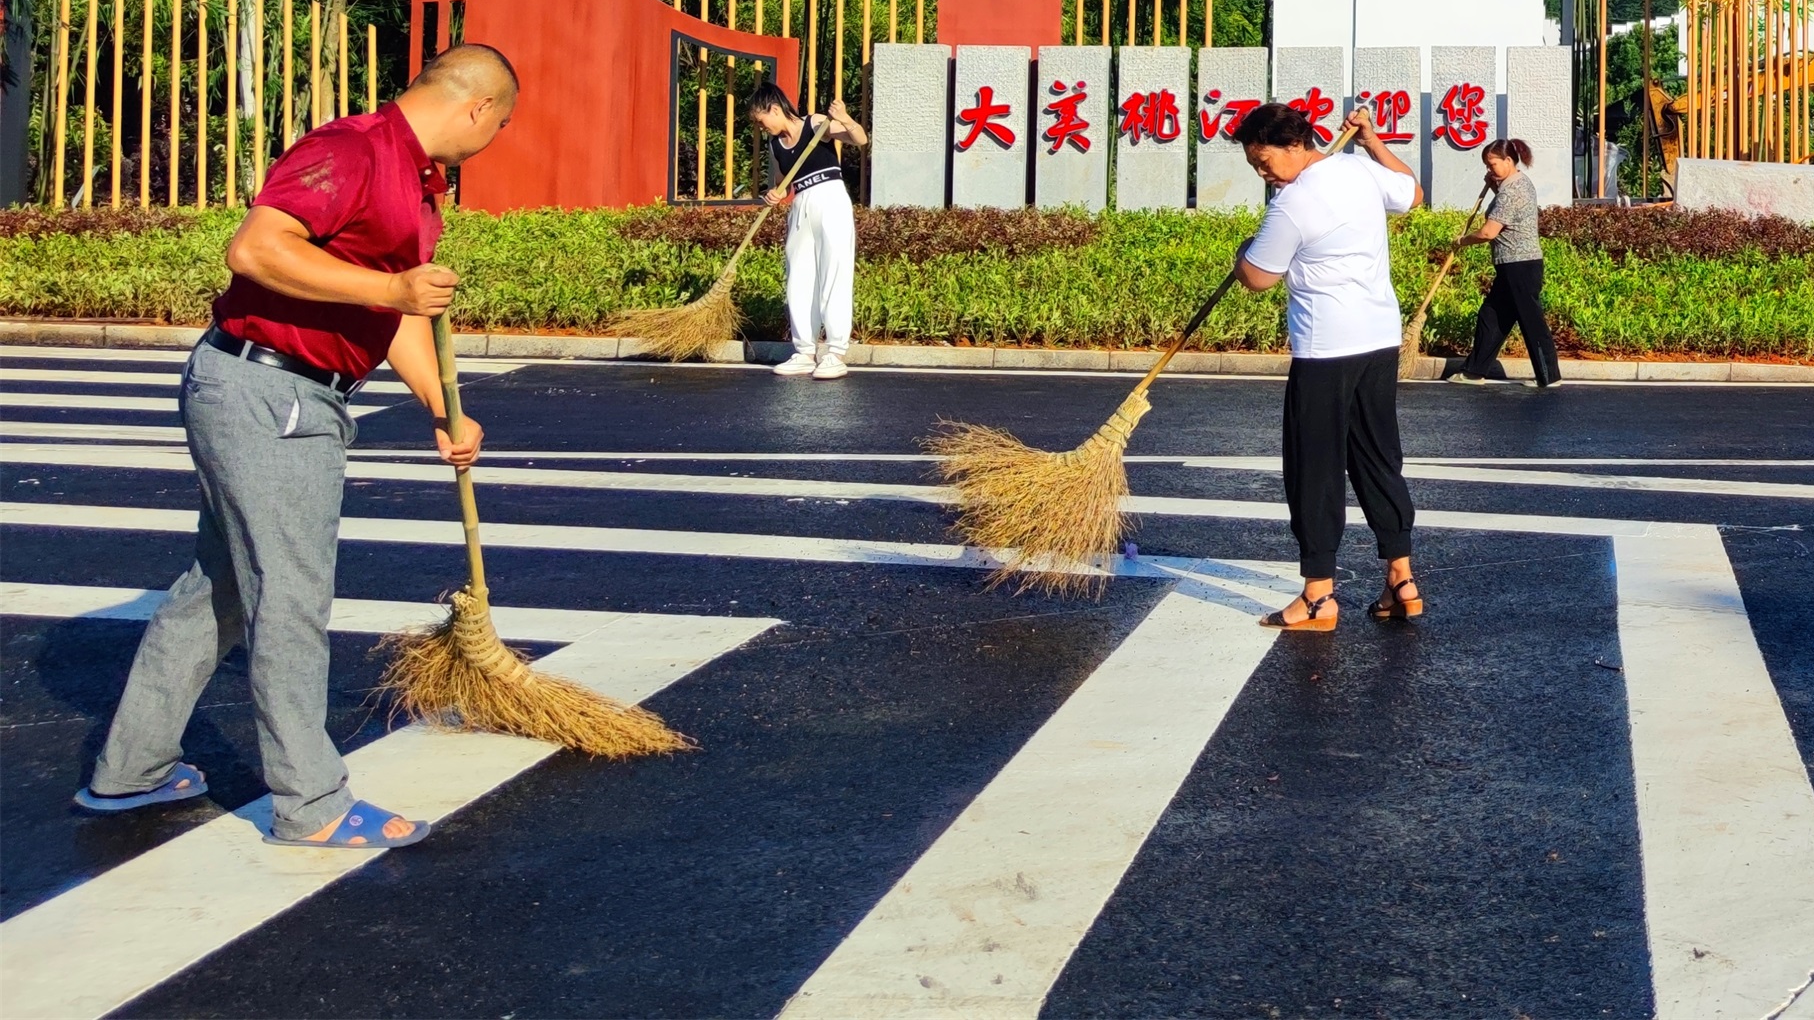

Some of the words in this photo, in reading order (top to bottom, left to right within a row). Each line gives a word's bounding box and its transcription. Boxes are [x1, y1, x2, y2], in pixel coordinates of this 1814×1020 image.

[958, 80, 1489, 149] 大美桃江欢迎您
[795, 173, 830, 191] ANEL
